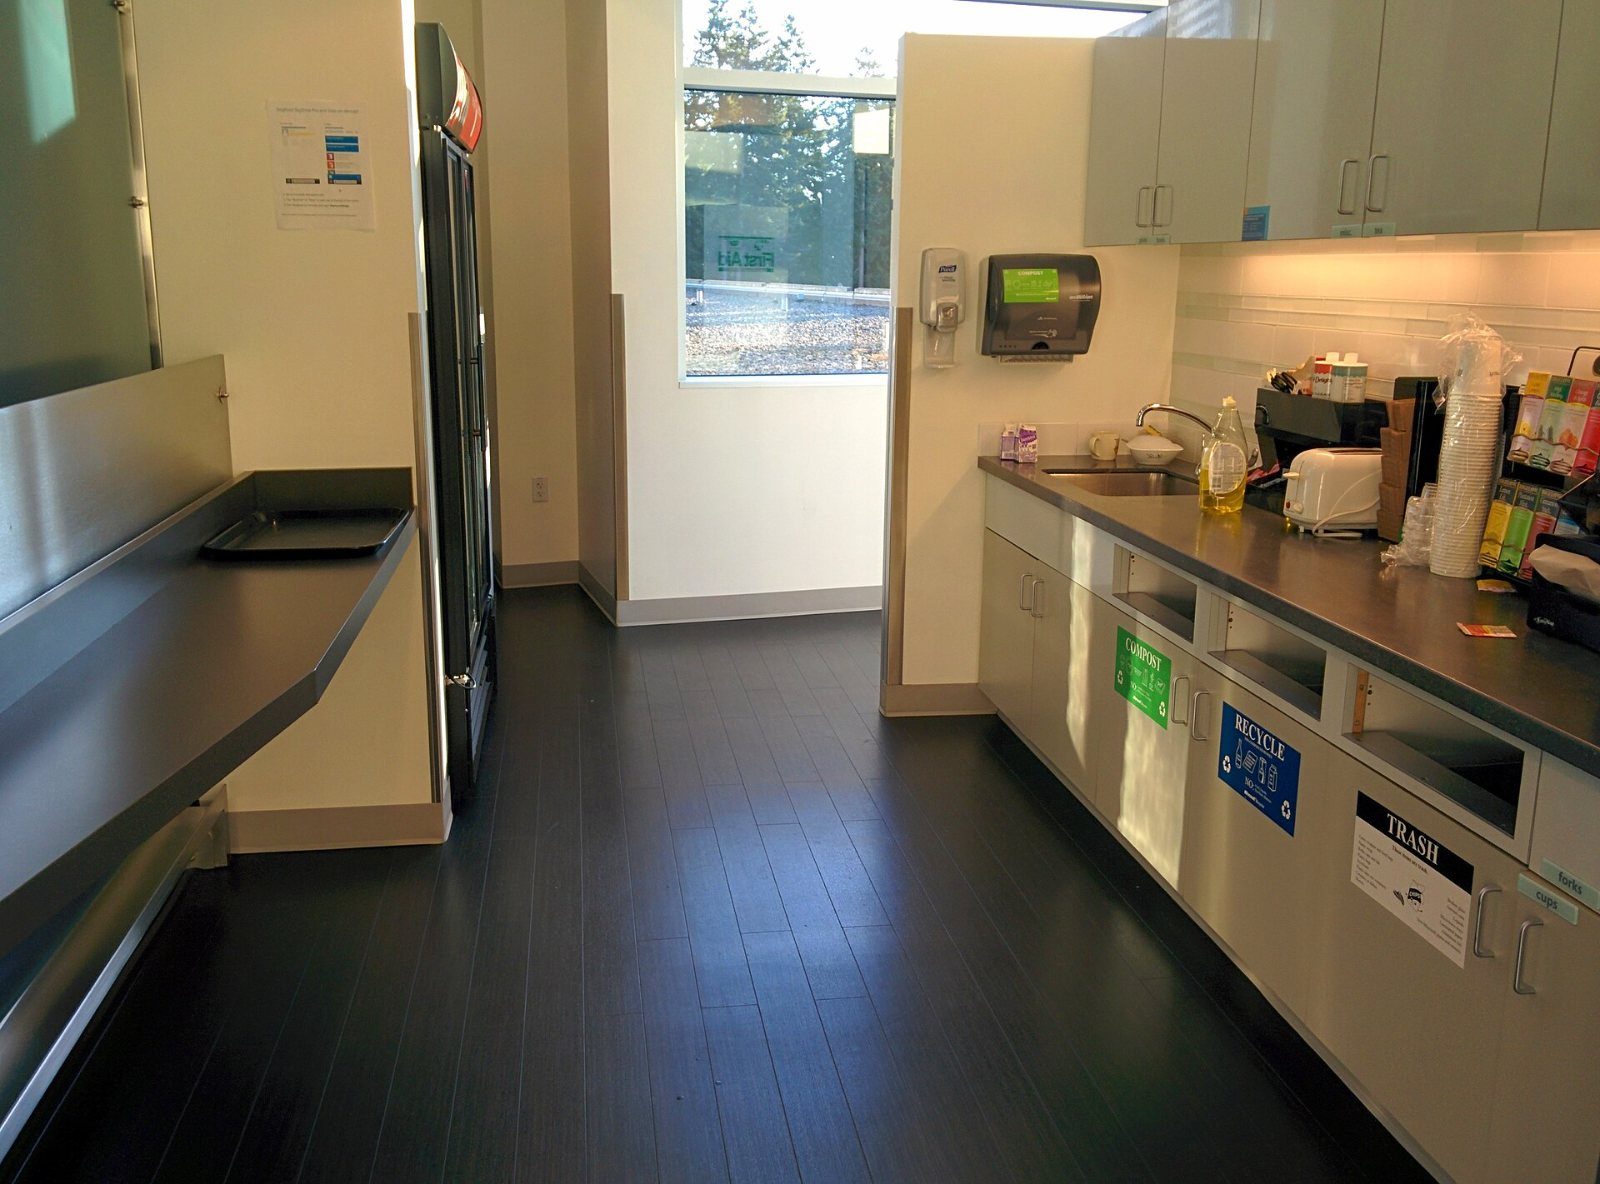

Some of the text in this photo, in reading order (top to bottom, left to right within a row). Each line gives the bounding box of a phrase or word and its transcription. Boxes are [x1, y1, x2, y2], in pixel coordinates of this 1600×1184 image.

[1125, 637, 1162, 671] COMPOST
[1235, 713, 1285, 762] RECYCLE
[1386, 812, 1440, 866] TRASH
[1558, 871, 1584, 895] forks
[1535, 890, 1559, 912] cups
